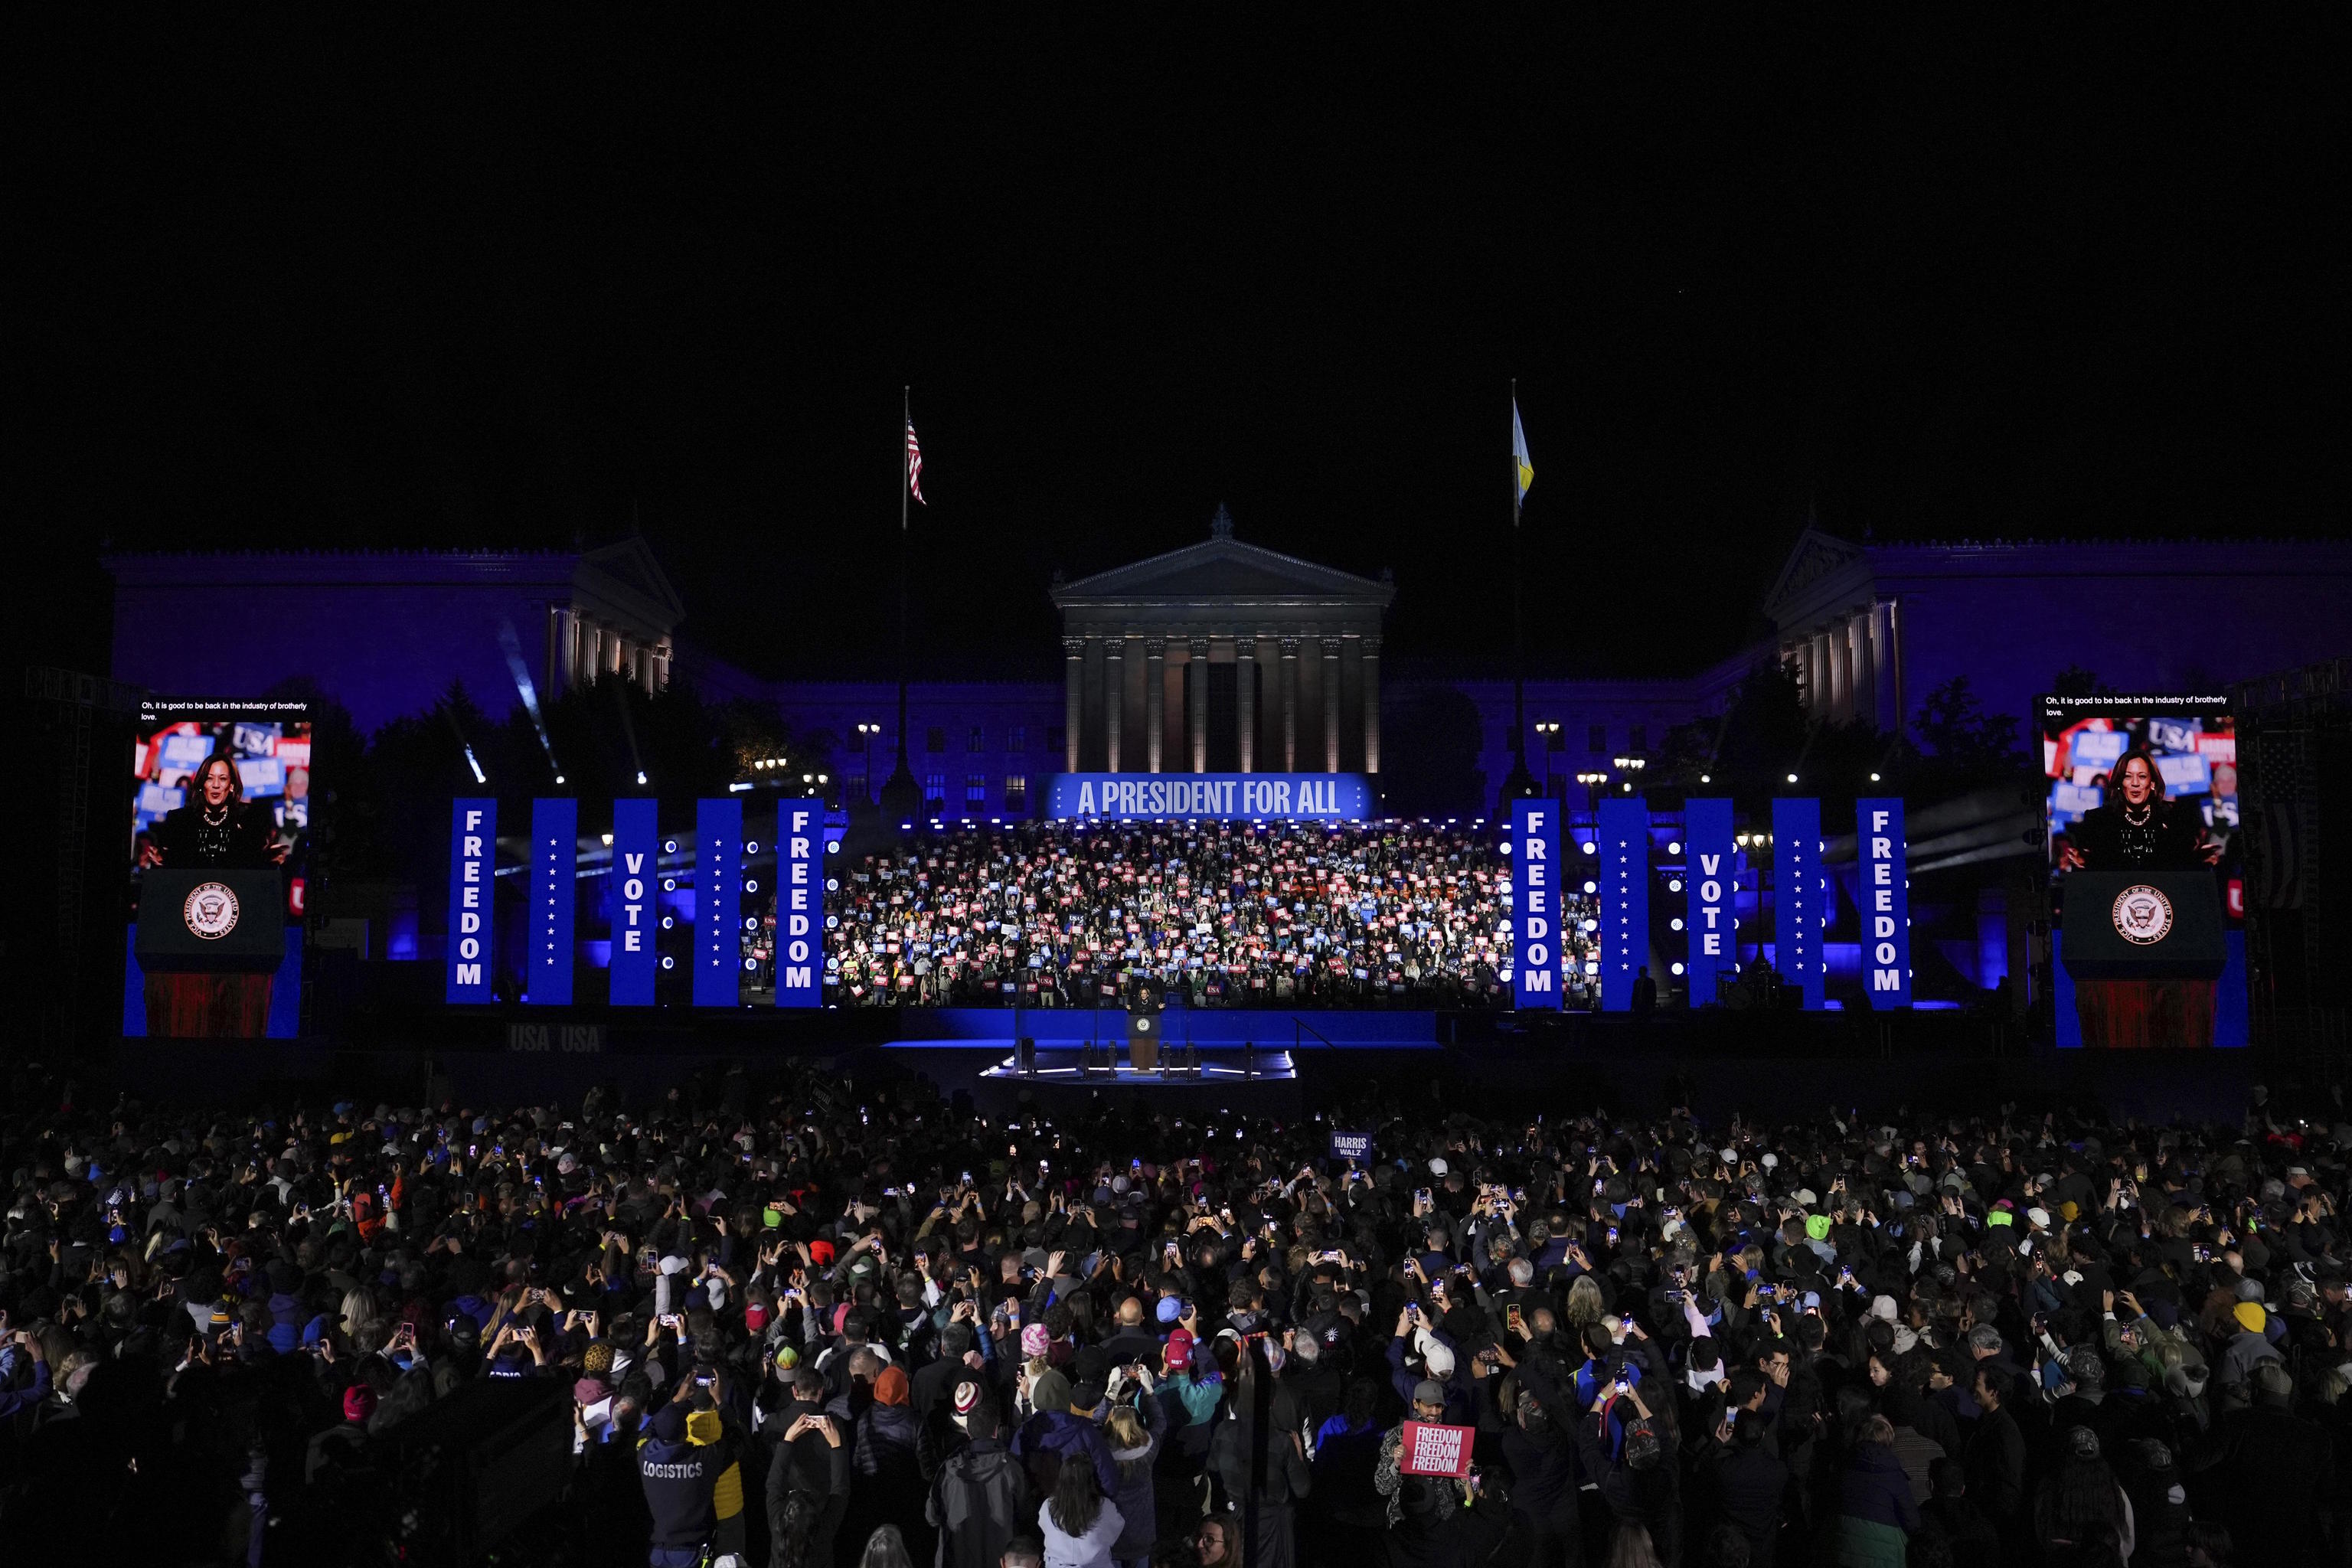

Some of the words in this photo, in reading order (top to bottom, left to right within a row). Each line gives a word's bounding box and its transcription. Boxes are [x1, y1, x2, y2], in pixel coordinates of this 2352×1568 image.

[142, 702, 154, 710] Oh,
[168, 702, 185, 711] good
[242, 702, 268, 711] industry
[278, 702, 307, 711] brotherly
[2046, 697, 2059, 705] Oh,
[2075, 697, 2093, 706] good
[2155, 697, 2184, 705] industry
[2195, 696, 2227, 705] brotherly
[2047, 708, 2063, 717] love.
[233, 724, 274, 756] USA
[2148, 724, 2195, 756] USA
[1078, 782, 1096, 814] A
[1102, 782, 1237, 814] PRESIDENT
[1244, 781, 1290, 814] FOR
[1297, 781, 1341, 814] ALL
[185, 887, 202, 921] PRESIDENT
[223, 888, 238, 912] UNITED
[457, 811, 482, 985] FREEDOM
[624, 853, 644, 952] VOTE
[786, 812, 811, 988] FREEDOM
[1526, 812, 1551, 991] FREEDOM
[1700, 854, 1721, 955] VOTE
[1873, 811, 1900, 991] FREEDOM
[2115, 891, 2131, 926] PRESIDENT
[2154, 890, 2171, 916] UNITED
[191, 923, 202, 936] VICE
[219, 914, 237, 935] STATES
[2120, 926, 2134, 942] VICE
[2152, 918, 2171, 941] STATES
[511, 1025, 550, 1051] USA
[561, 1026, 599, 1052] USA
[1334, 1136, 1367, 1149] HARRIS
[1416, 1426, 1462, 1445] FREEDOM
[1415, 1442, 1461, 1459] FREEDOM
[643, 1461, 703, 1478] LOGISTICS
[1412, 1455, 1459, 1473] FREEDOM
